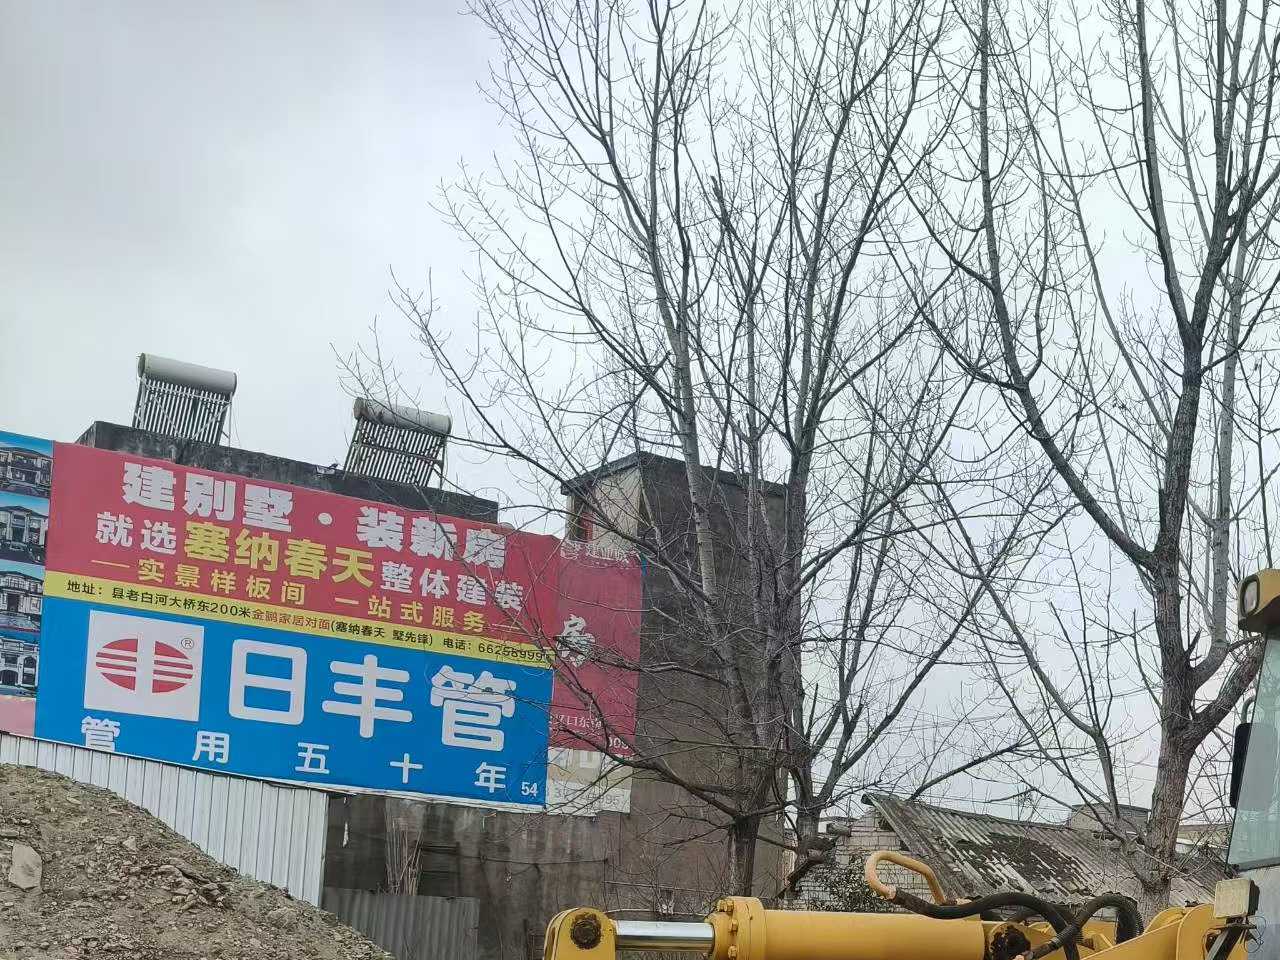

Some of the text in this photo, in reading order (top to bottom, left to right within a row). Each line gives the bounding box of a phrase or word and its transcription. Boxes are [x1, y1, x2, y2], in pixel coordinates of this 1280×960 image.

[94, 511, 525, 612] 就选塞纳春天整体建装
[136, 558, 486, 634] 实景样板间 一站式服务
[228, 638, 517, 752] 日丰管
[81, 715, 507, 795] 管用五十年
[520, 781, 540, 799] 54
